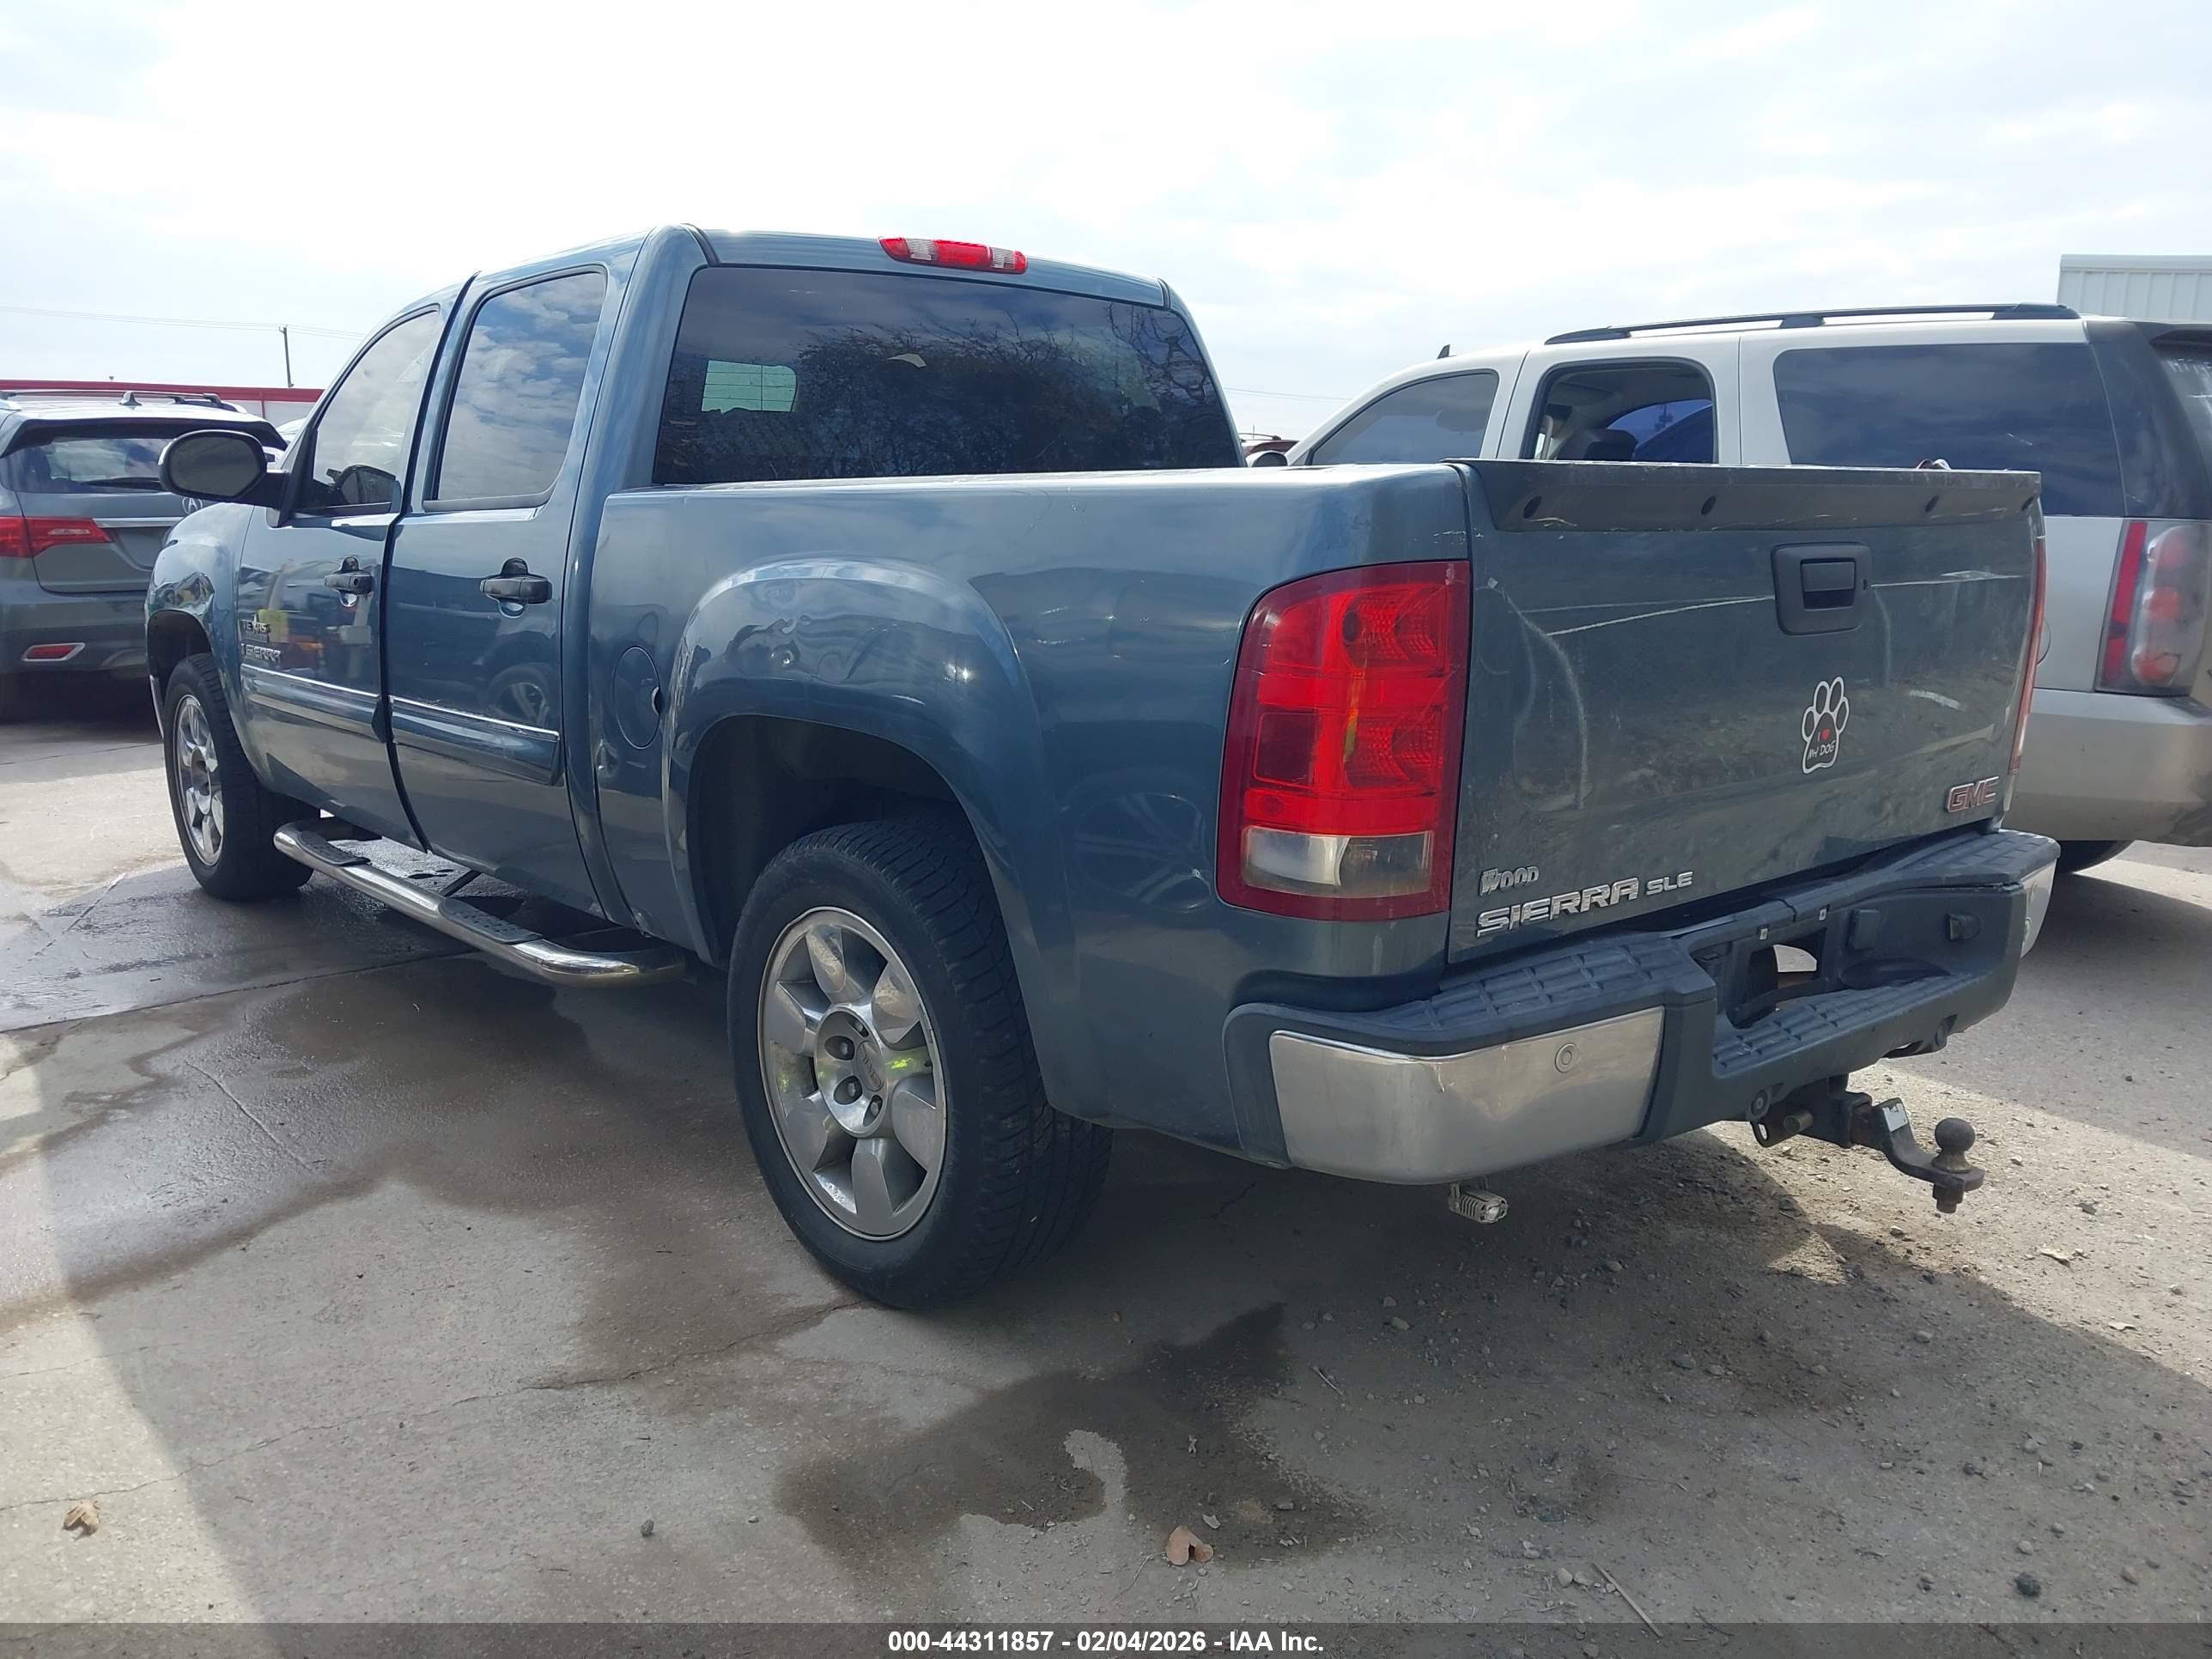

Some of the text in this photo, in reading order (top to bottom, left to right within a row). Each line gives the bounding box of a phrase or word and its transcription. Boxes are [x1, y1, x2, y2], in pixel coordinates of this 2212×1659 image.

[1820, 740, 1836, 756] DOG
[1947, 775, 2000, 812] GMC
[1476, 871, 1694, 938] SIERRA SLE
